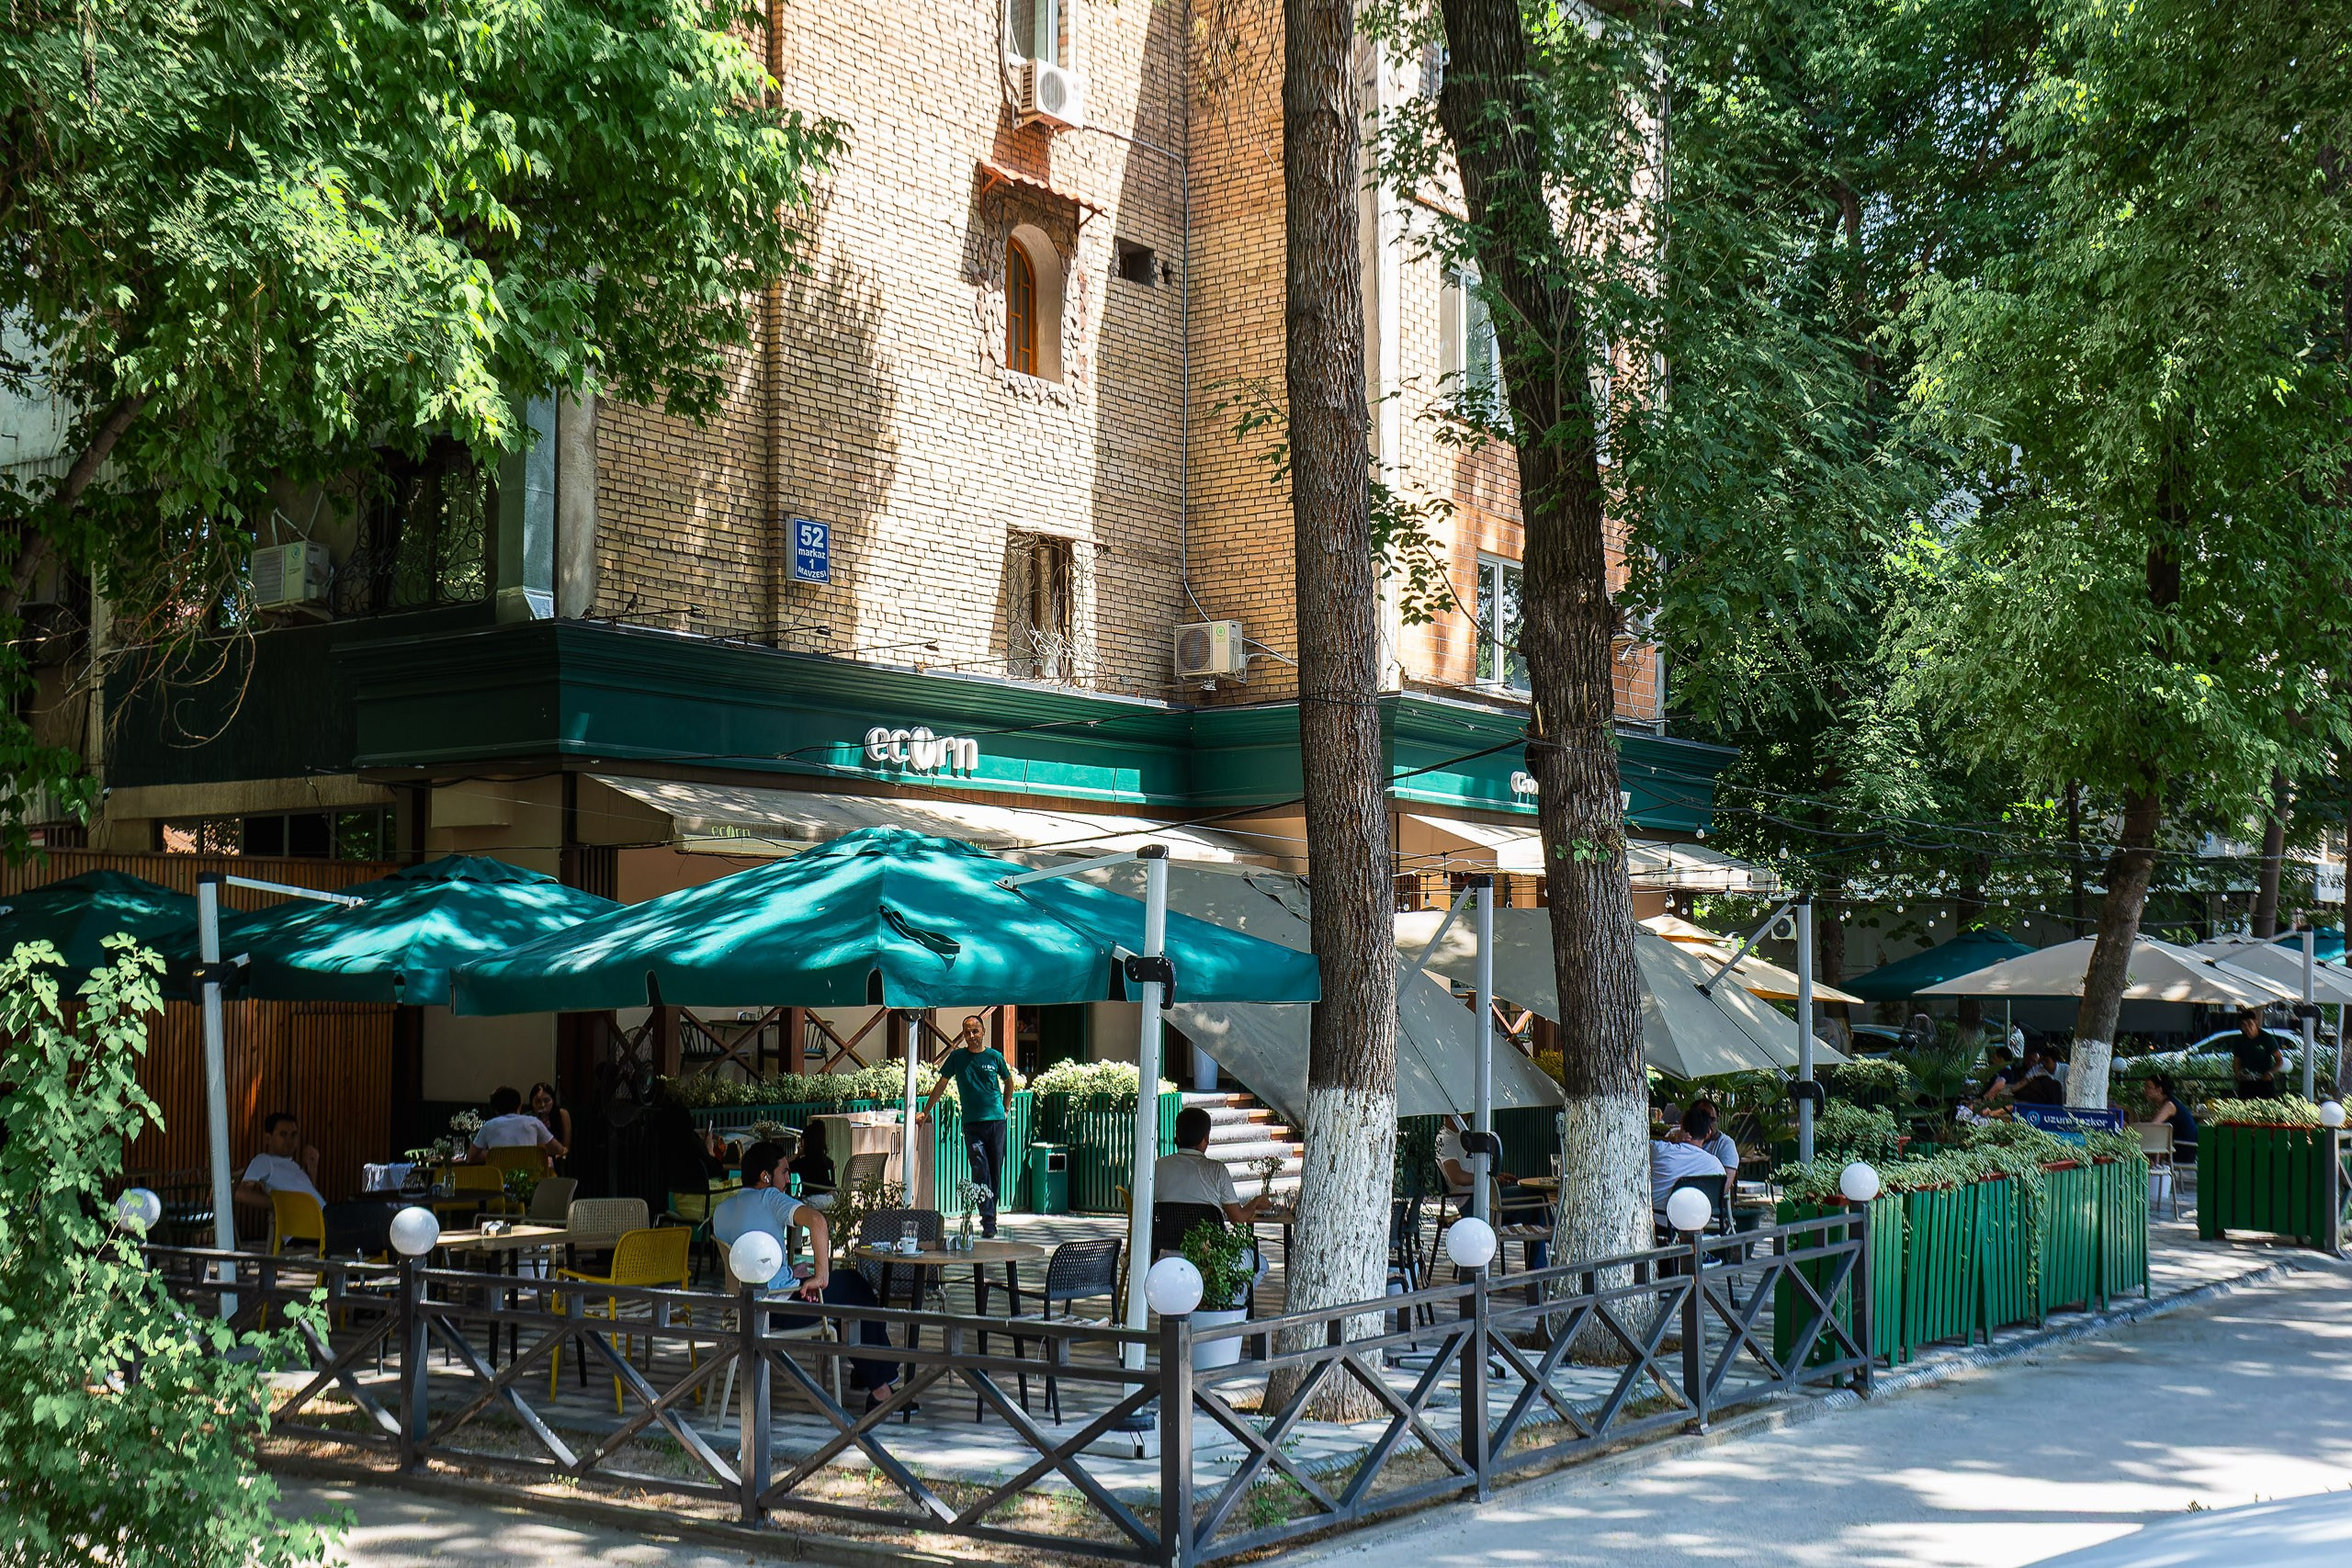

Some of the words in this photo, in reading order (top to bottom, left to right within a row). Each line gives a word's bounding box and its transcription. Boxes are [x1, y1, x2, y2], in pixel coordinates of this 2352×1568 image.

[800, 525, 824, 548] 52
[798, 548, 826, 559] markaz
[808, 558, 815, 570] 1
[797, 566, 827, 578] MAVZESI
[865, 726, 978, 771] ecorn
[2074, 1117, 2109, 1127] zkor
